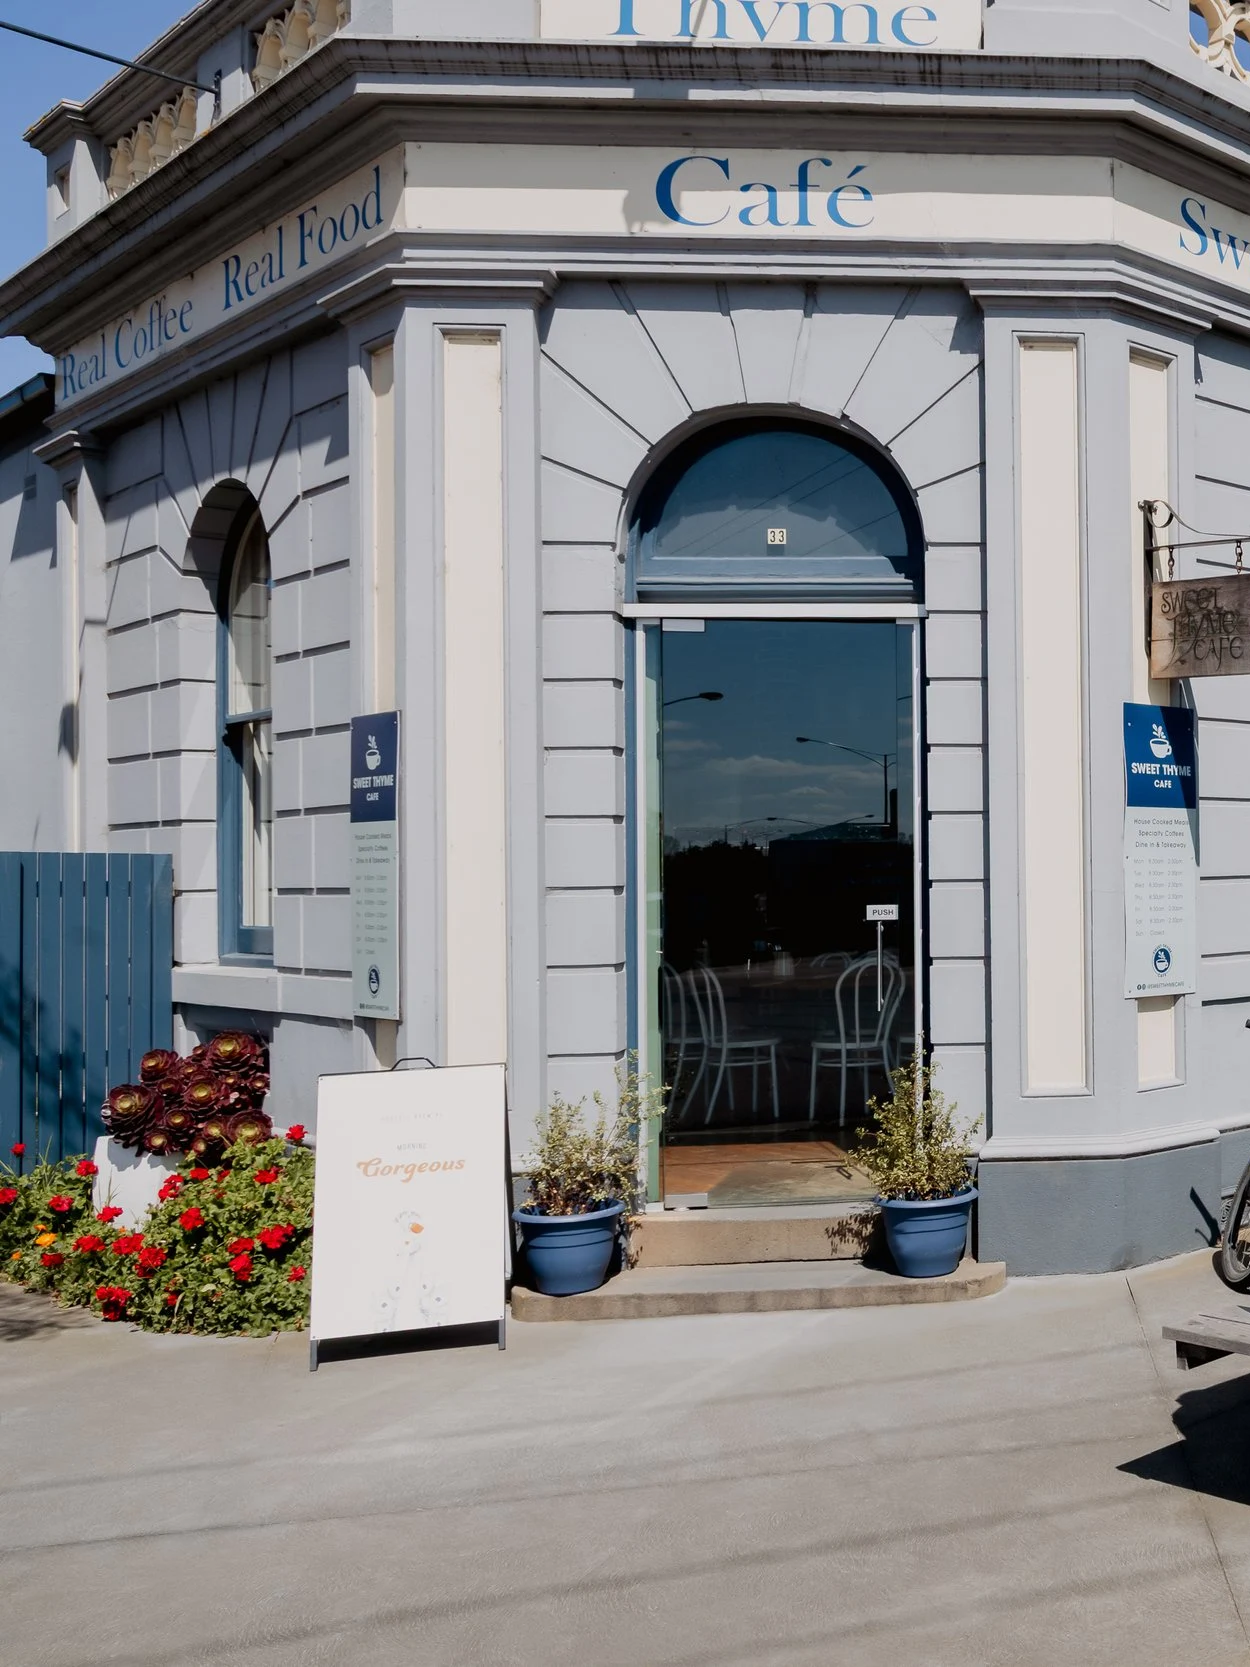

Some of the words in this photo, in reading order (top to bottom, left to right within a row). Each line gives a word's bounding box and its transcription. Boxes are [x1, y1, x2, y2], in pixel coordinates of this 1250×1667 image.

[655, 156, 875, 228] Café
[62, 333, 107, 401] Real
[114, 295, 194, 369] Coffee
[222, 226, 286, 311] Real
[296, 165, 385, 271] Food
[770, 530, 785, 543] 33
[1131, 762, 1160, 775] SWEET
[1162, 764, 1192, 777] THYME
[353, 777, 372, 789] SWEET
[372, 774, 394, 787] THYME
[1154, 779, 1172, 789] CAFE
[366, 792, 379, 801] CAFE
[356, 1157, 467, 1183] Gorgeous
